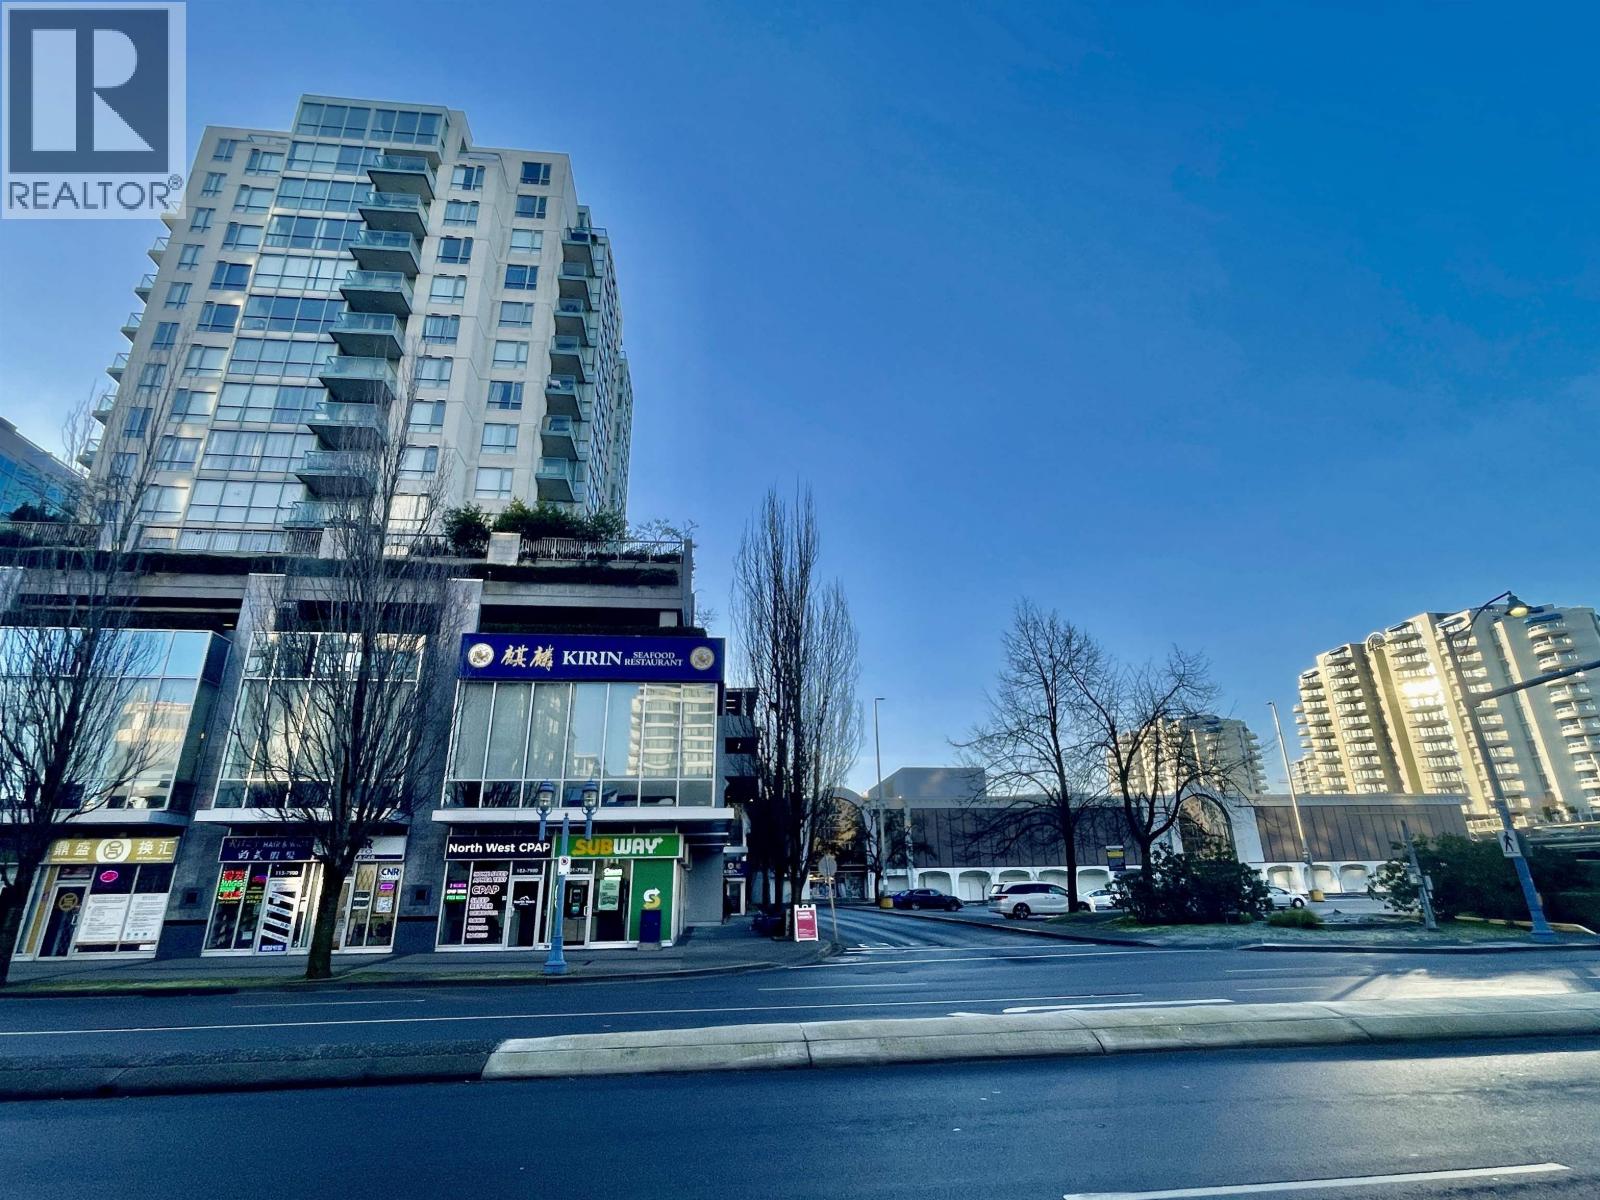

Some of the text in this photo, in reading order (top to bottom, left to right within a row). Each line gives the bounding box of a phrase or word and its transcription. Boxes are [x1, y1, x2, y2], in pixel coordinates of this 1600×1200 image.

[501, 644, 623, 671] 麒麟 KIRIN
[633, 651, 675, 660] SEAFOOD
[624, 658, 683, 667] RESTAURANT
[53, 840, 175, 856] 鼎盛 换汇
[448, 843, 551, 853] North West CPAP
[571, 837, 663, 856] SUBWAY
[381, 867, 400, 876] CNR
[471, 885, 500, 895] CPAP
